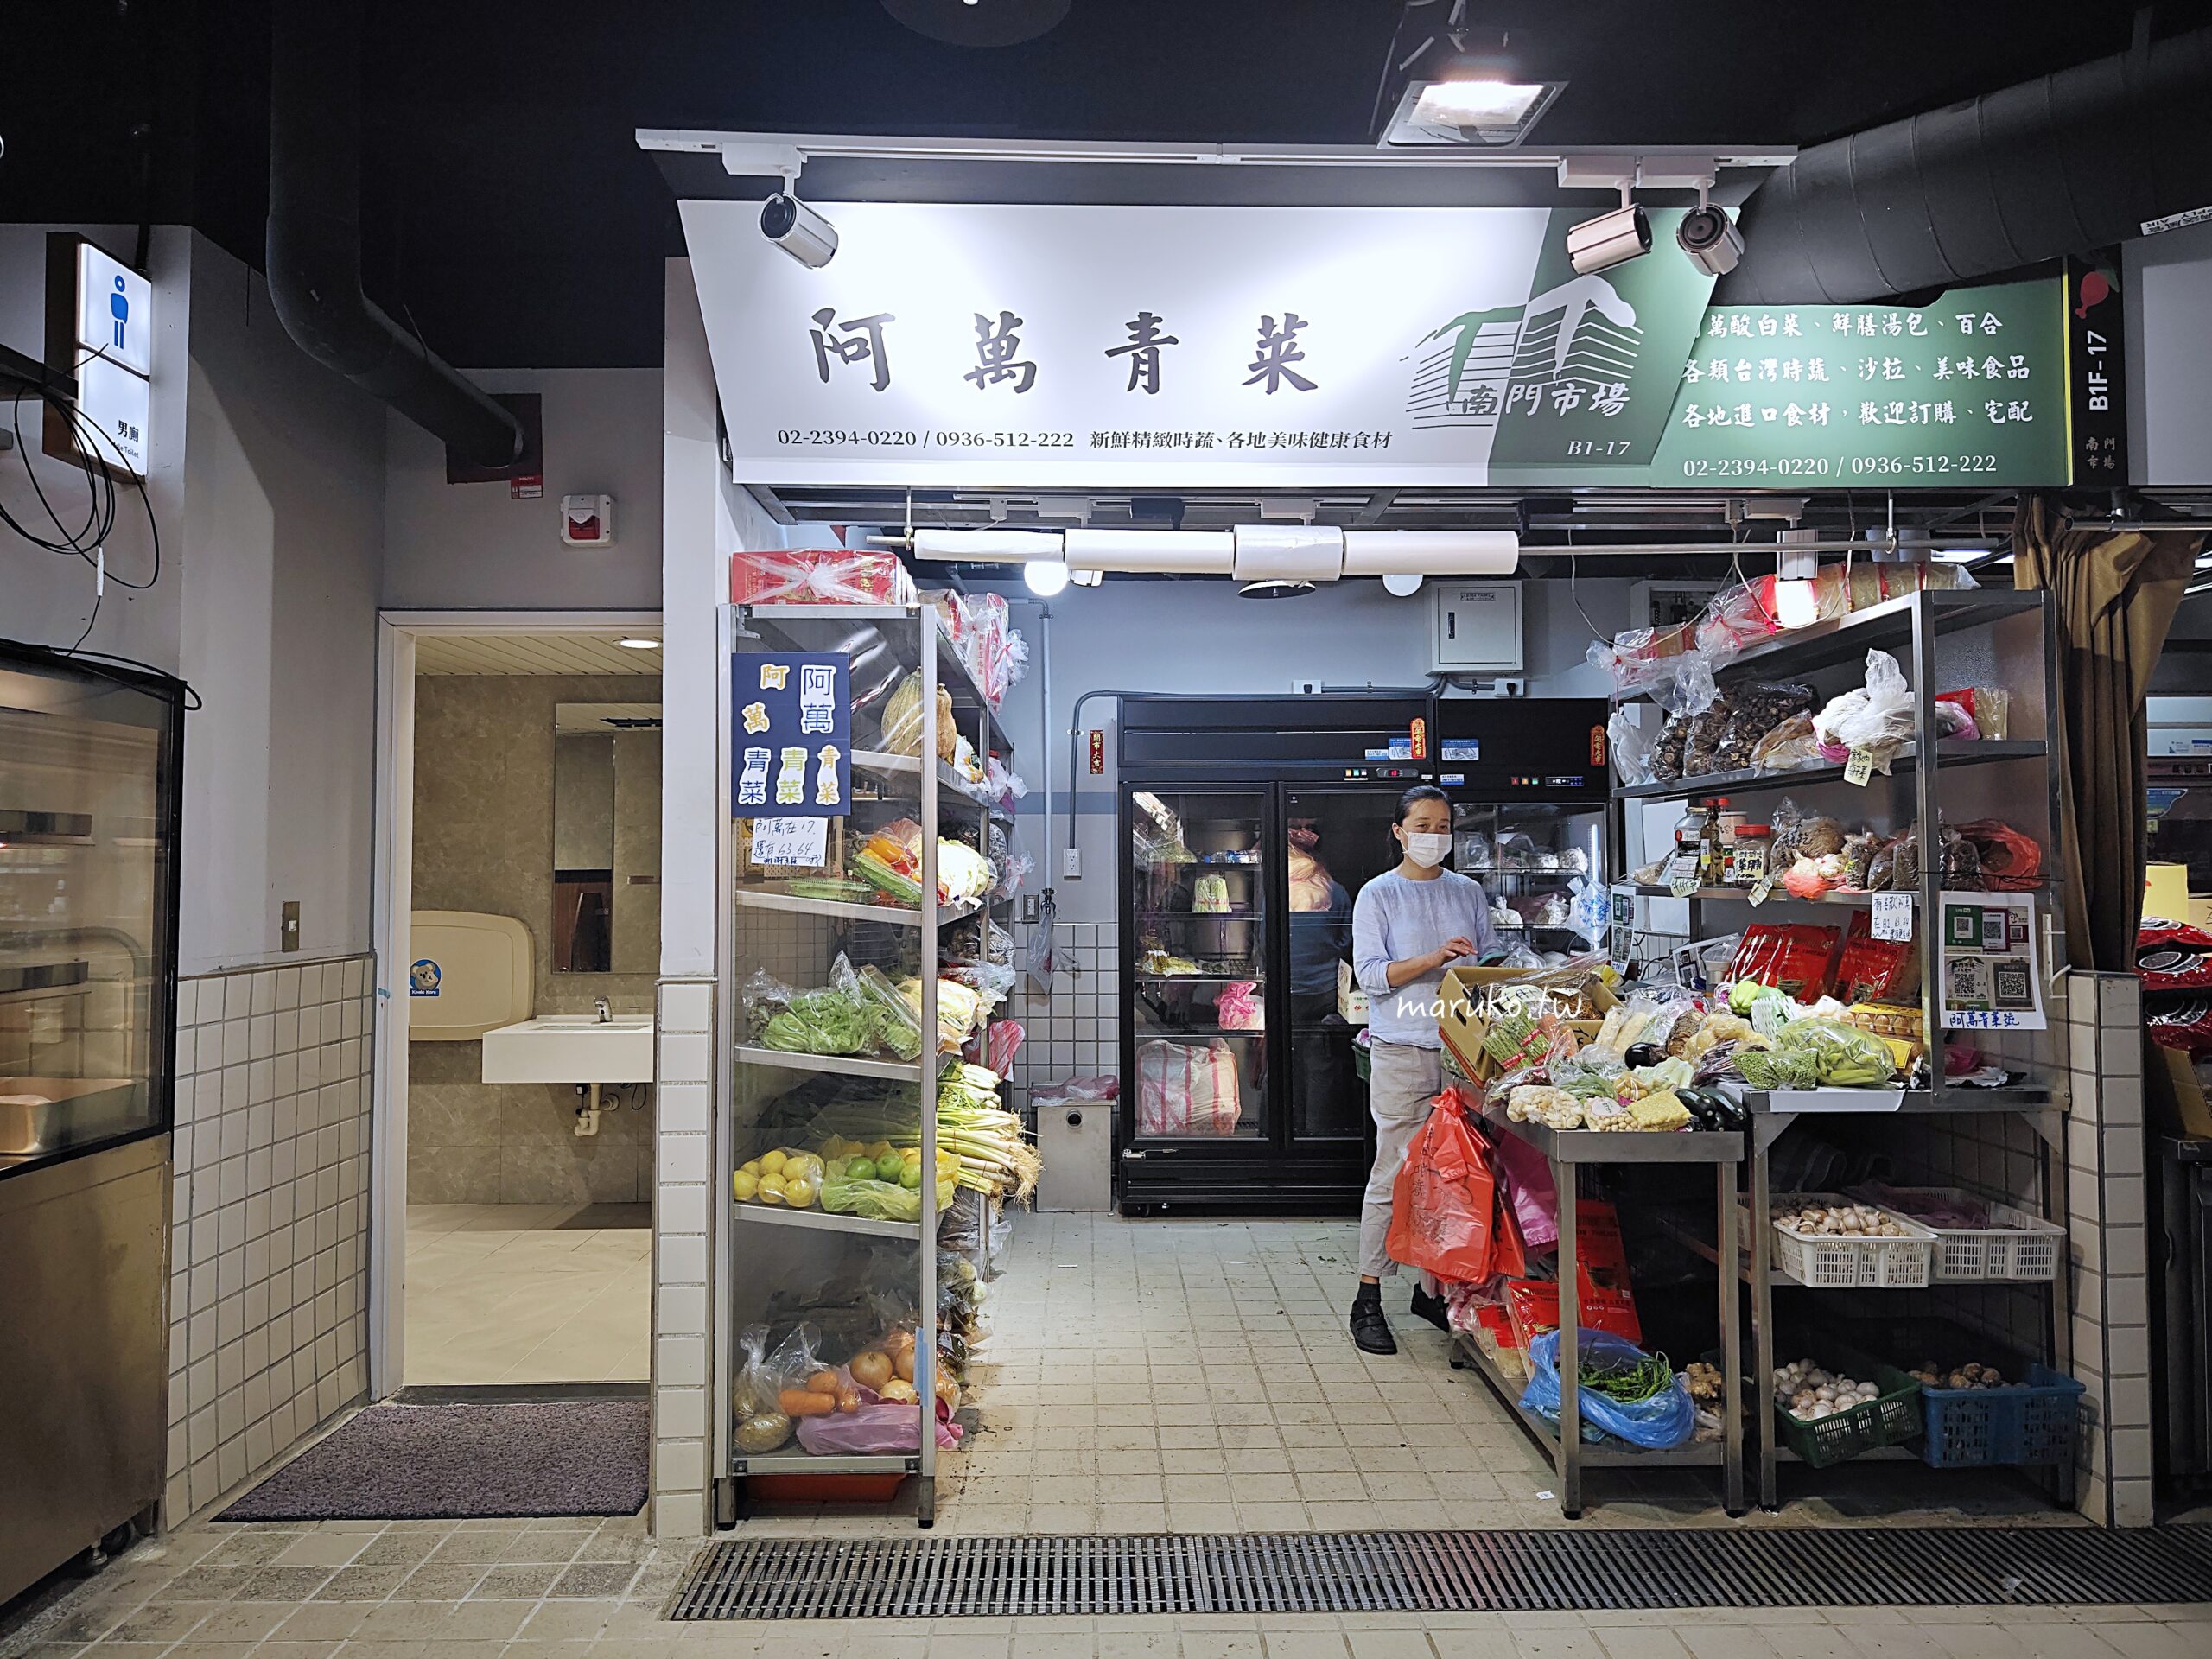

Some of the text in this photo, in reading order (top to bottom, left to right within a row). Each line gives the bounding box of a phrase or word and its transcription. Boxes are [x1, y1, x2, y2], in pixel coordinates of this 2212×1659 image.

[1696, 312, 2003, 339] 萬酸白菜、鮮膳湯包、百合
[809, 308, 1319, 395] 阿萬青菜
[2087, 330, 2109, 410] B1F-17
[1462, 382, 1630, 417] 南門市場
[118, 420, 139, 442] 男廁
[777, 429, 917, 446] 02-2394-0220
[936, 431, 1075, 448] 0936-512-222
[1565, 441, 1631, 456] B1-17
[124, 446, 139, 458] Toilet
[1683, 459, 1829, 477] 02-2394-0220
[1851, 454, 1997, 474] 0936-512-222
[803, 668, 832, 732] 阿萬
[741, 749, 769, 803] 青菜
[779, 749, 805, 802] 青菜
[819, 747, 838, 804] 青菜
